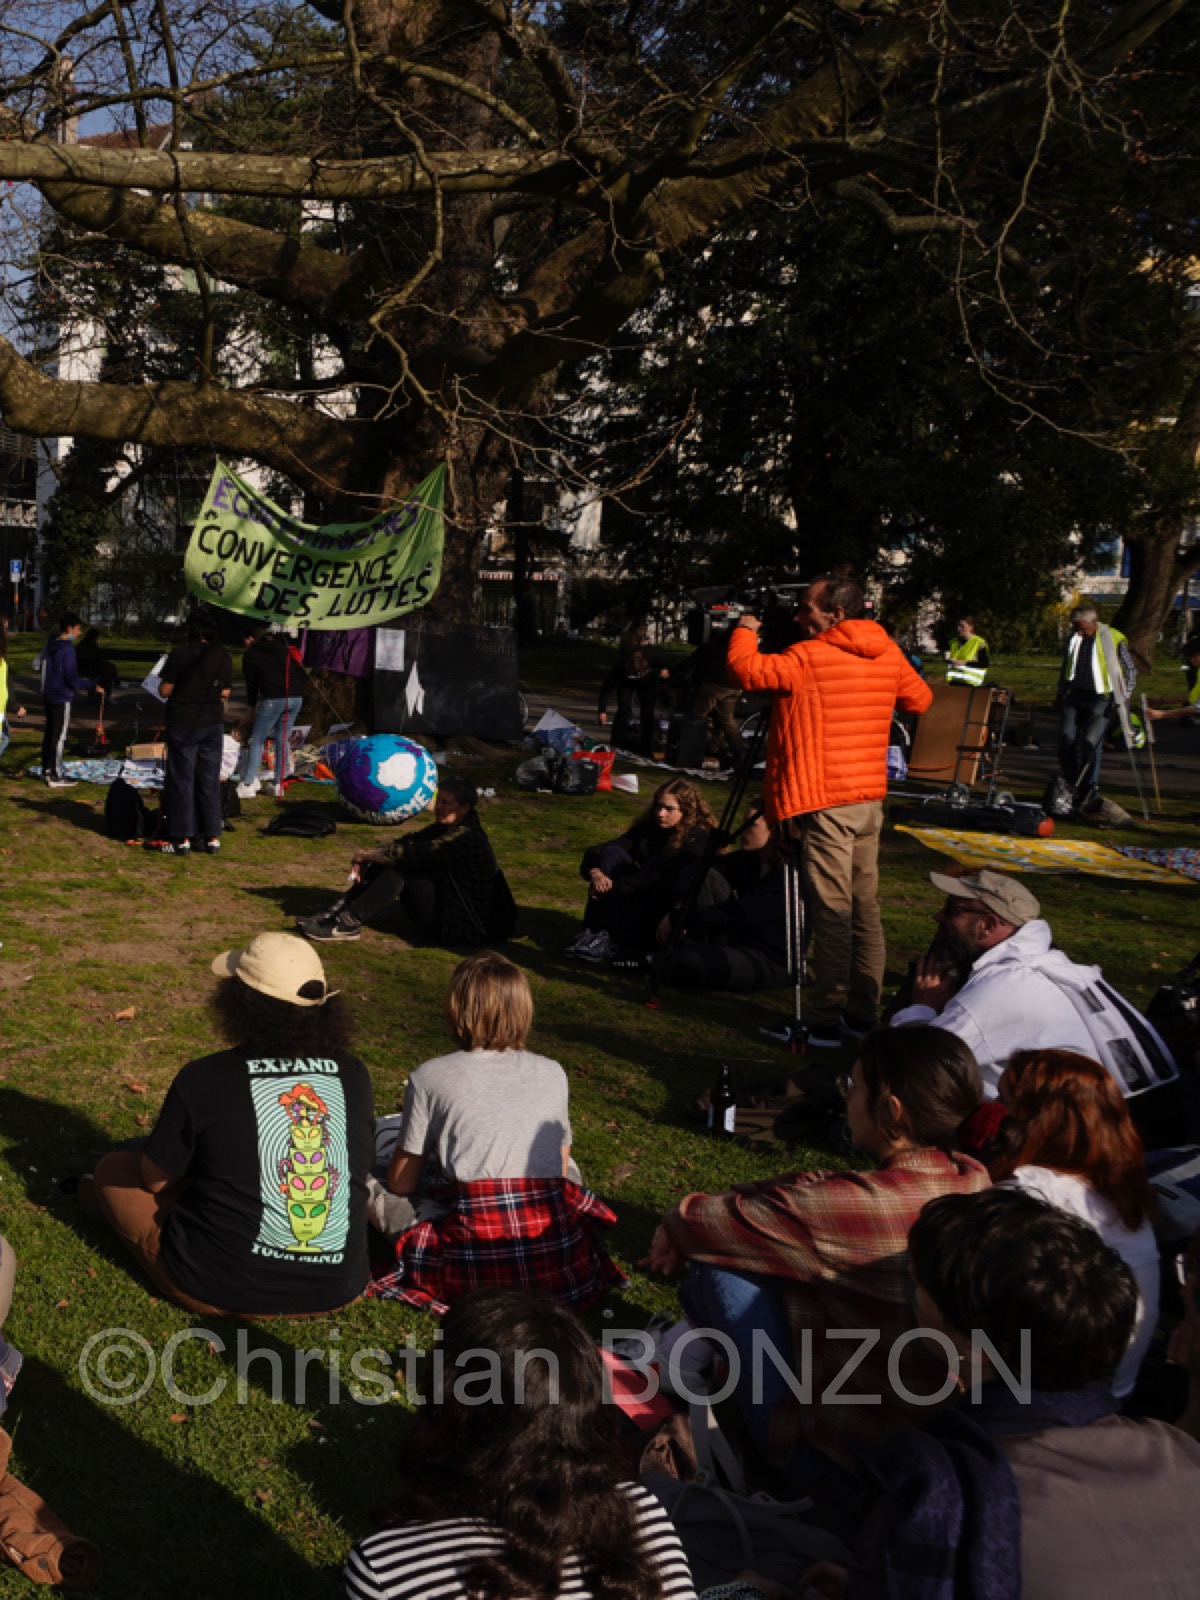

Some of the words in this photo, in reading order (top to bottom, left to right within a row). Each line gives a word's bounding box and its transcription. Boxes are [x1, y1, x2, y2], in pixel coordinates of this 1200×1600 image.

[197, 524, 398, 589] CONVERGENCE
[254, 581, 319, 618] DES
[326, 570, 432, 618] LUTTES
[246, 1057, 339, 1075] EXPAND
